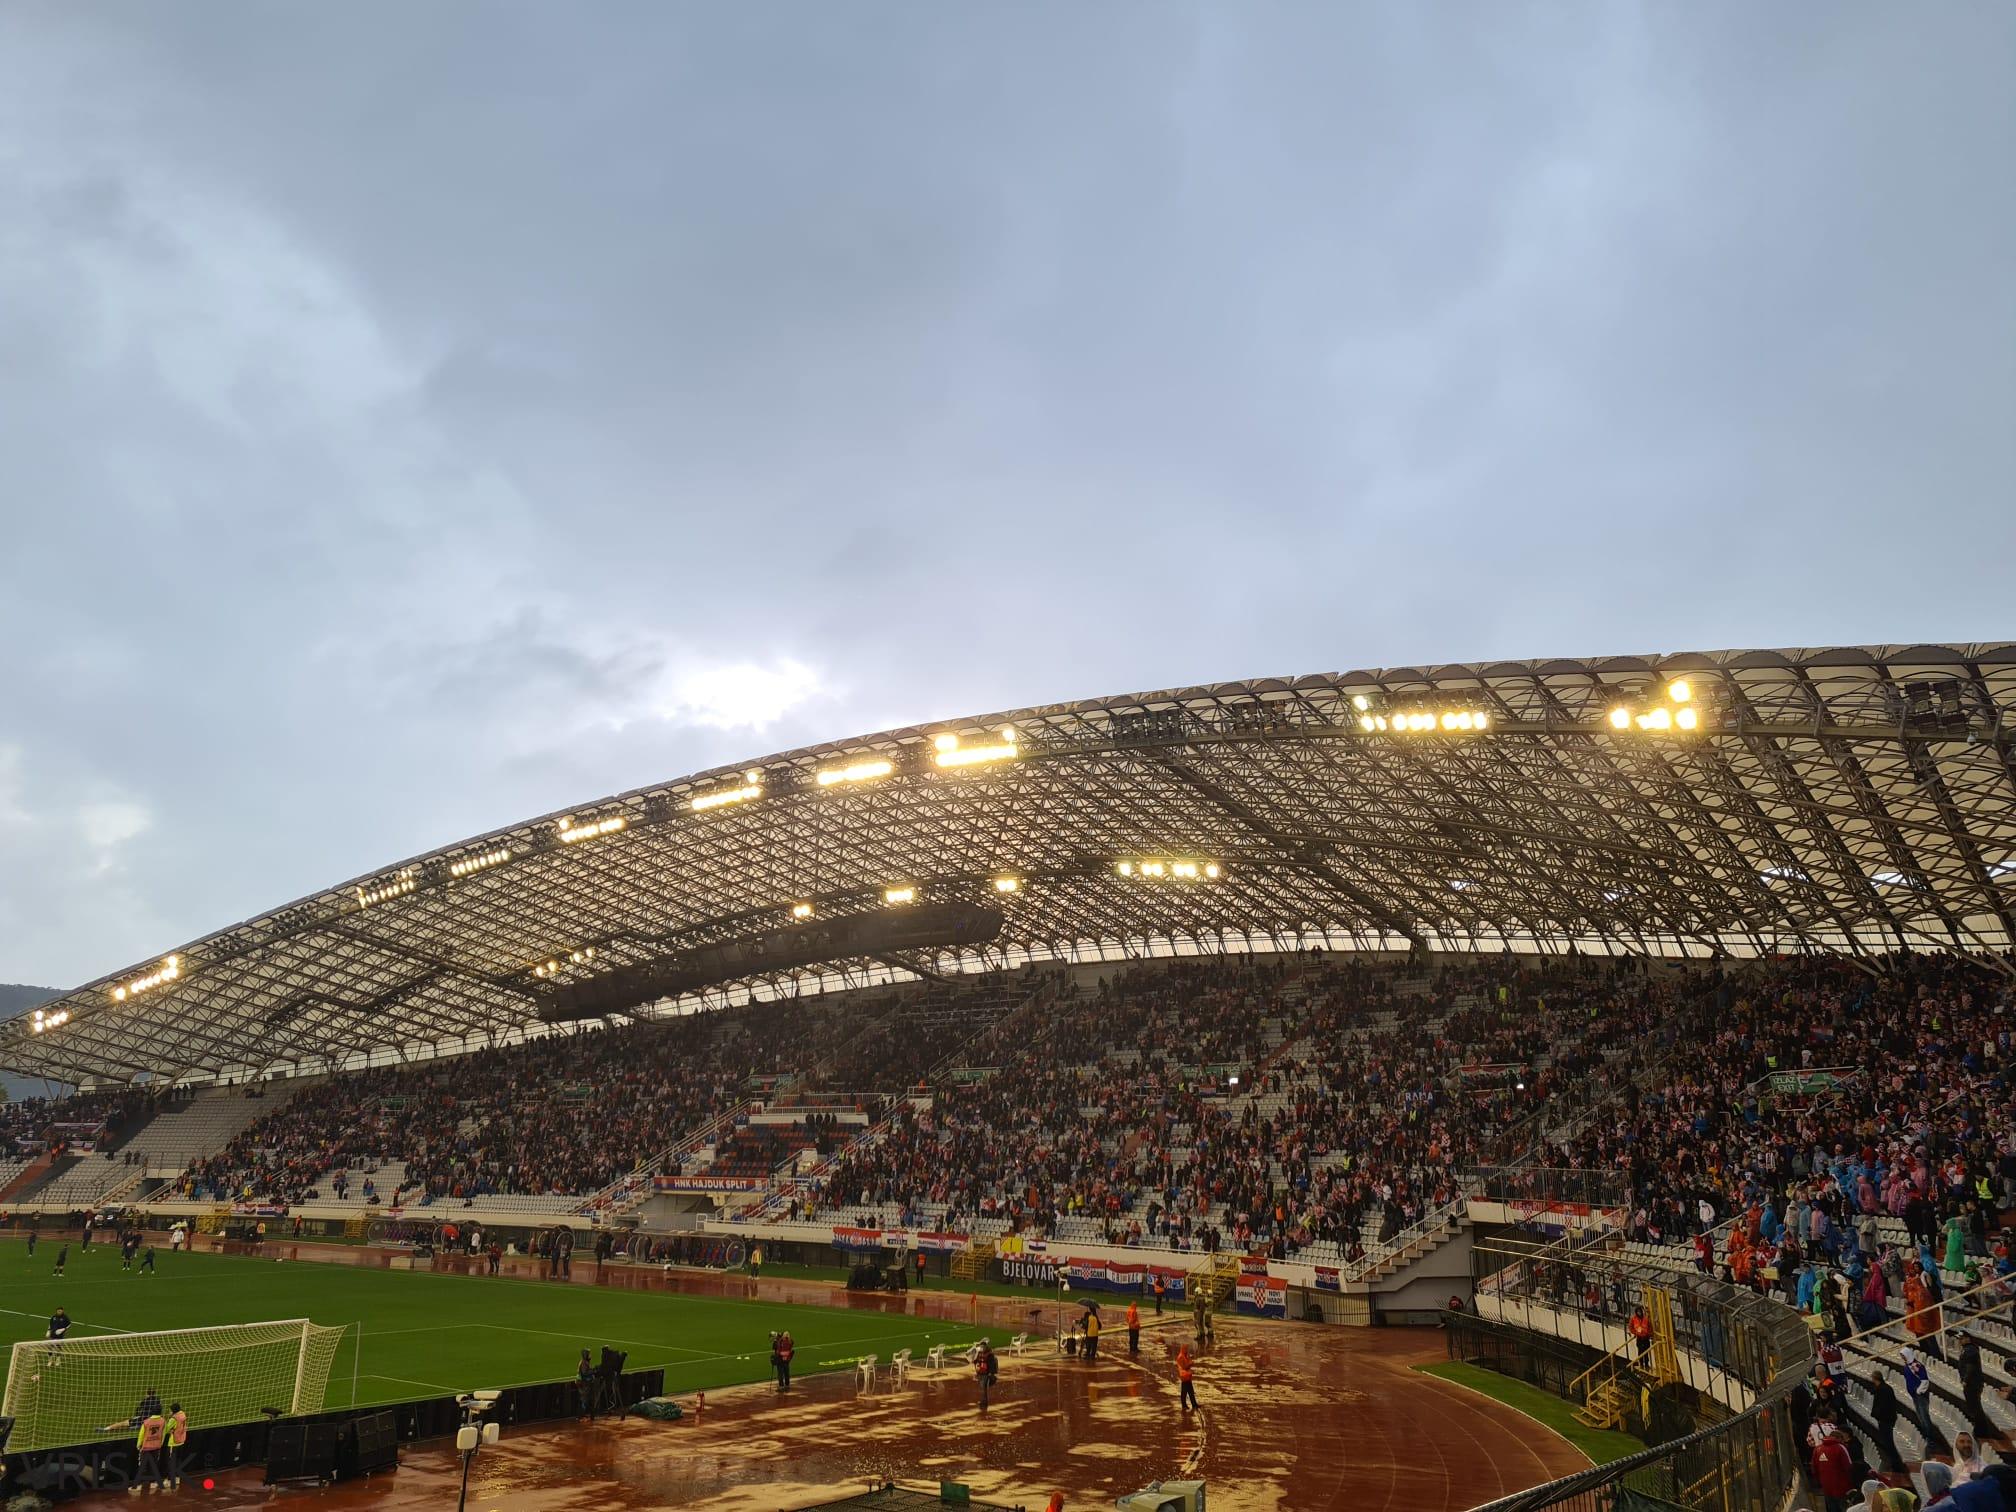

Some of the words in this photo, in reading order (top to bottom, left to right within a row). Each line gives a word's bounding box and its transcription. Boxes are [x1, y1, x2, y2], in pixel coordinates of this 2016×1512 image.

[1774, 1076, 1797, 1084] IZLAZ
[674, 1179, 691, 1188] HNK
[692, 1179, 725, 1189] HAJDUK
[725, 1180, 747, 1189] SPLIT
[1002, 1260, 1055, 1282] BJELOVAR
